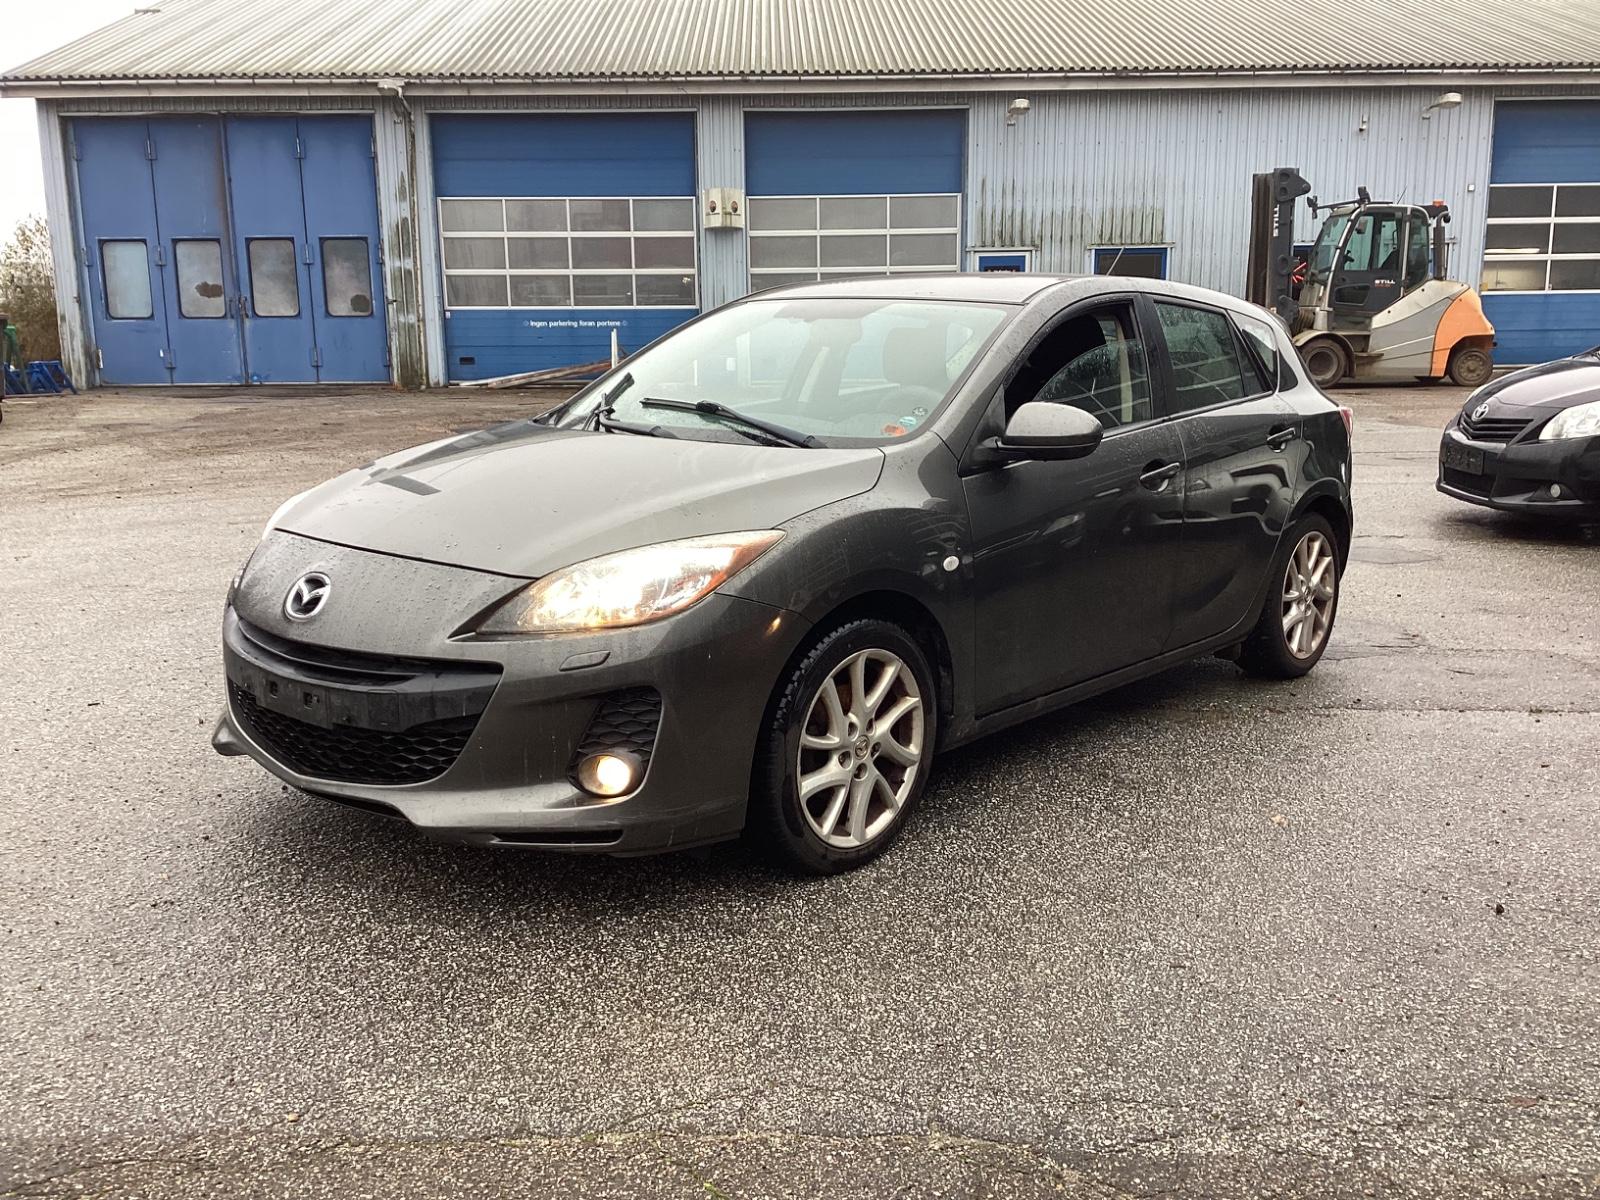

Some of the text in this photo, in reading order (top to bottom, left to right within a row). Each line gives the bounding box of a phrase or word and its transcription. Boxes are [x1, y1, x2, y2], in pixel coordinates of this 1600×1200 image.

[530, 320, 548, 328] Ingen
[548, 320, 578, 328] parkering
[596, 320, 620, 328] portene
